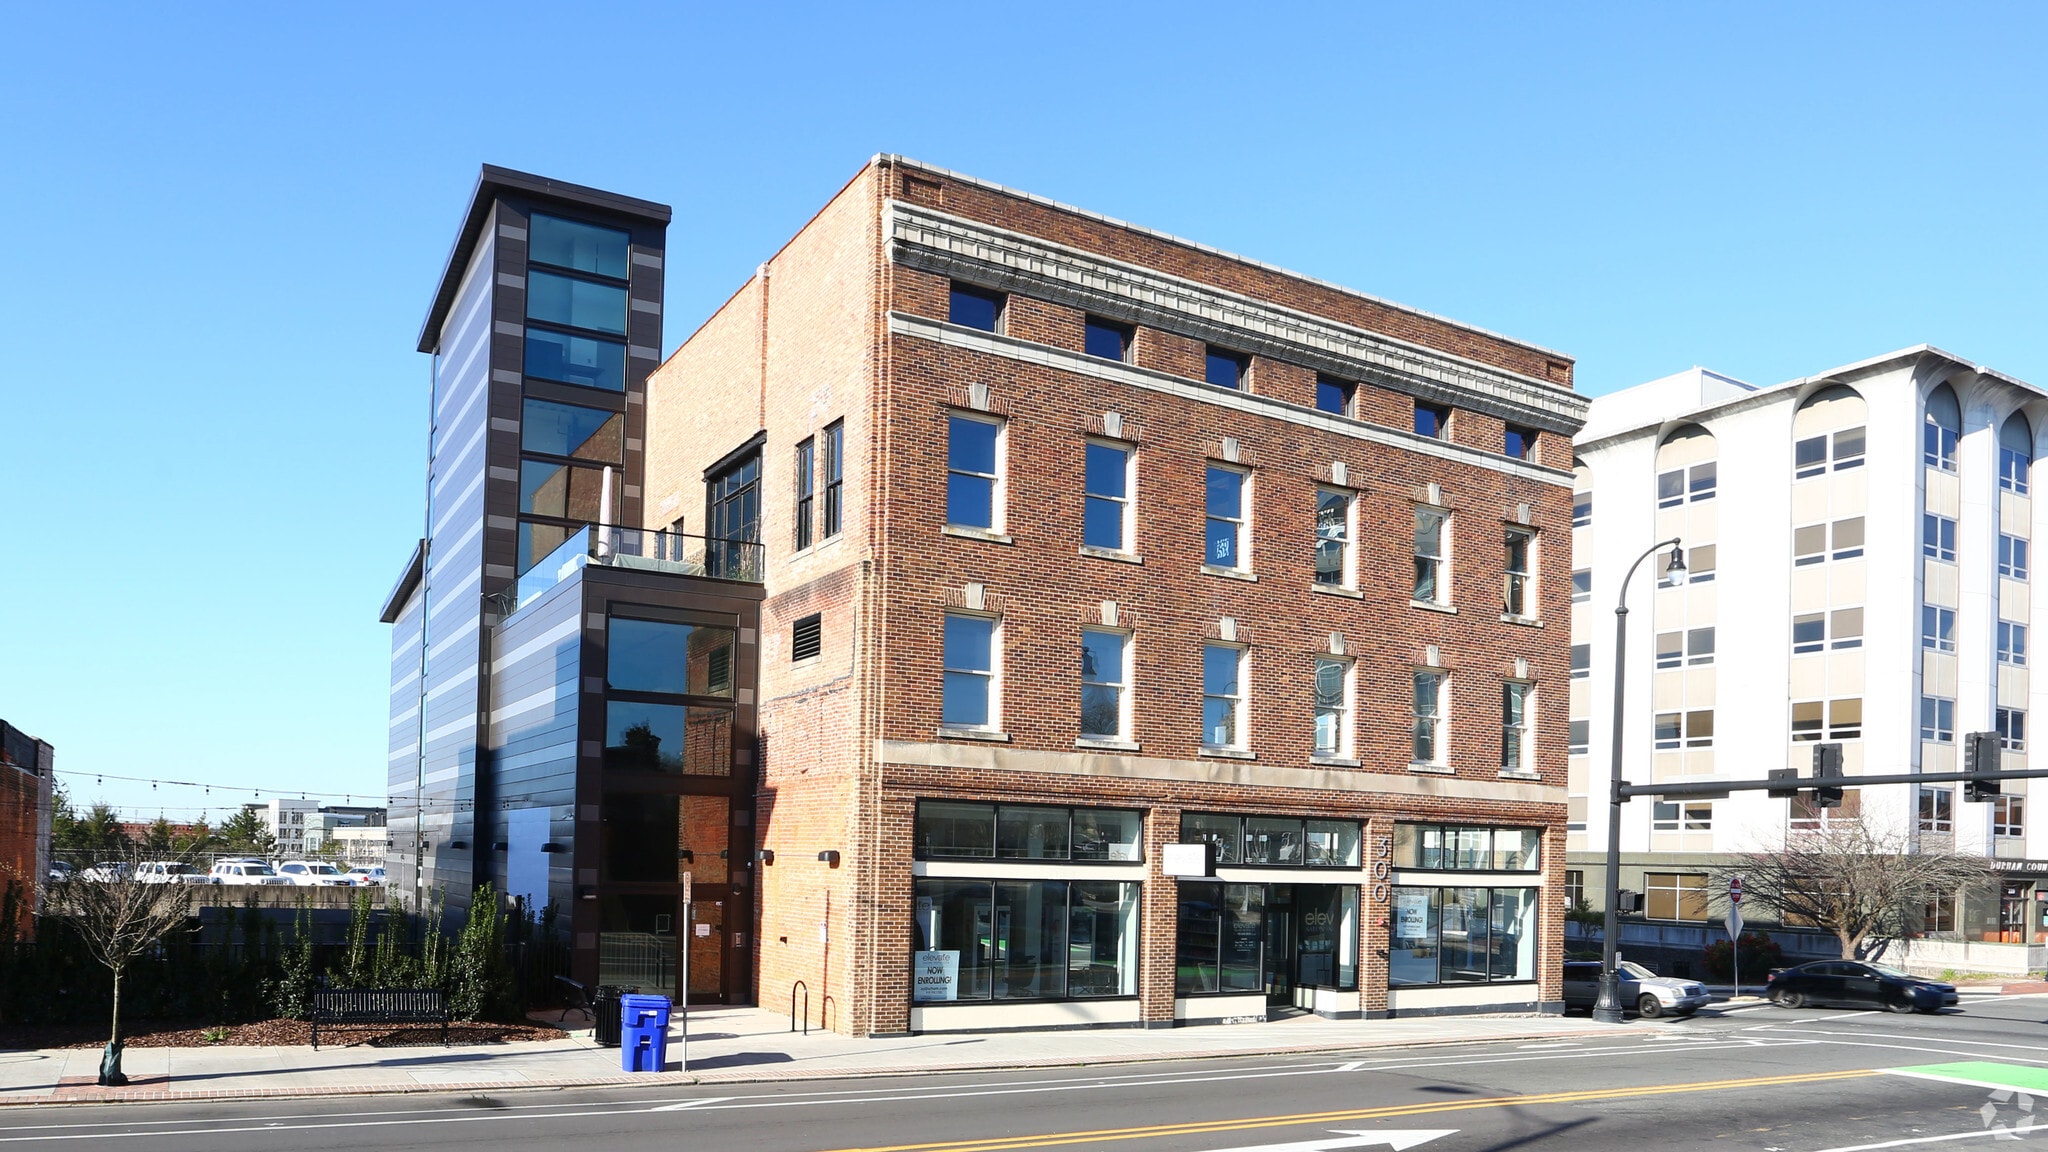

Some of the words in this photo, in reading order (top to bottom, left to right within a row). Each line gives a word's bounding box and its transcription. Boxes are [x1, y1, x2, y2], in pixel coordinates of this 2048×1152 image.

[1374, 836, 1387, 902] 300
[1990, 861, 2023, 871] DURHAM
[1305, 907, 1334, 925] elev
[923, 953, 951, 961] elevate
[927, 966, 944, 975] NOW
